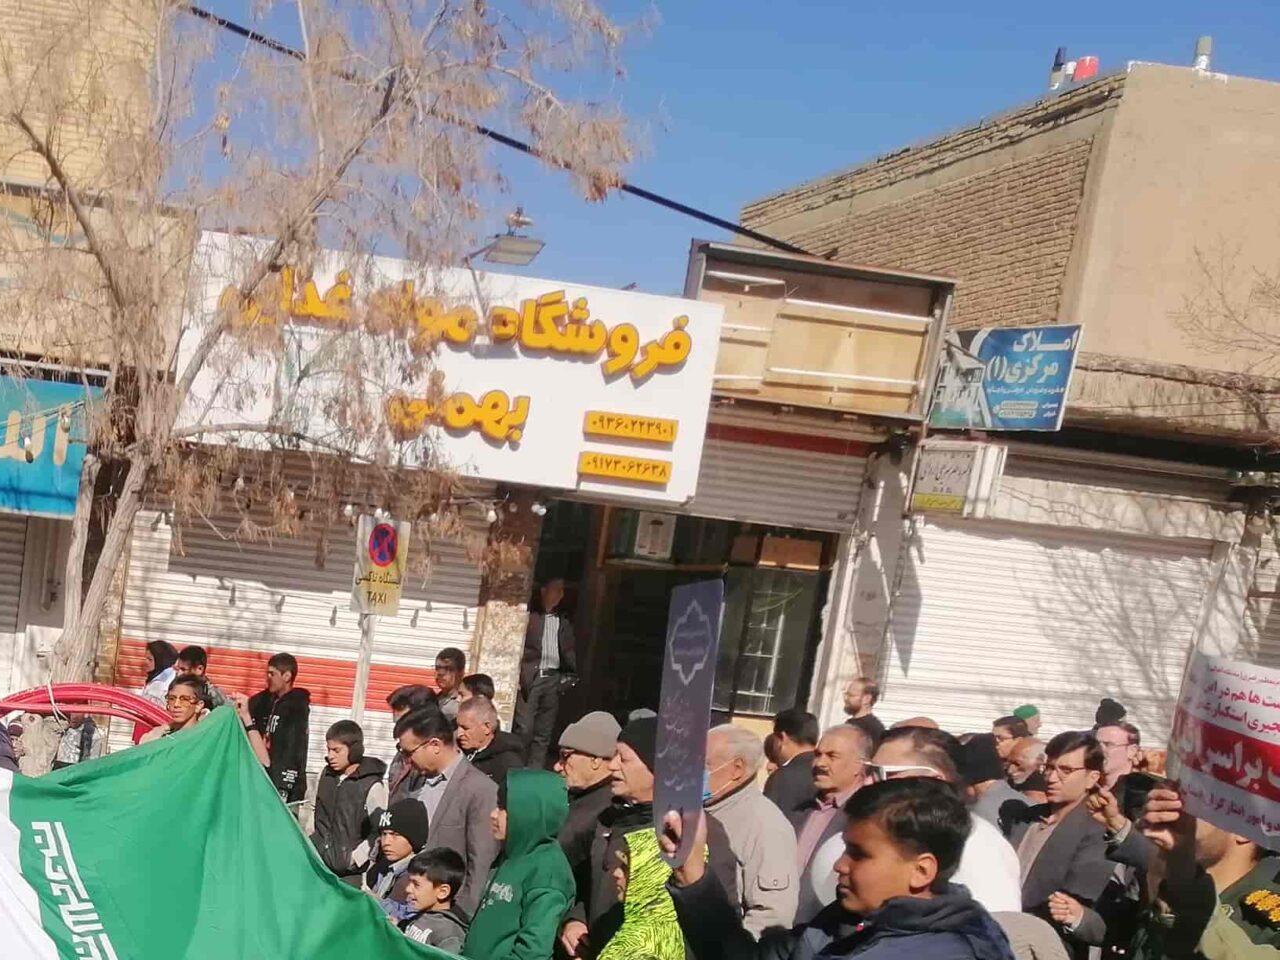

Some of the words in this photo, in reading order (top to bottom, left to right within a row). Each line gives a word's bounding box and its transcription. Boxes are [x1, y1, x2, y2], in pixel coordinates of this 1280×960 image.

[366, 278, 475, 344] موا
[490, 290, 693, 381] فروشگاه
[1013, 329, 1078, 352] املاک
[388, 390, 531, 442] بهمی
[367, 591, 387, 604] TAXI
